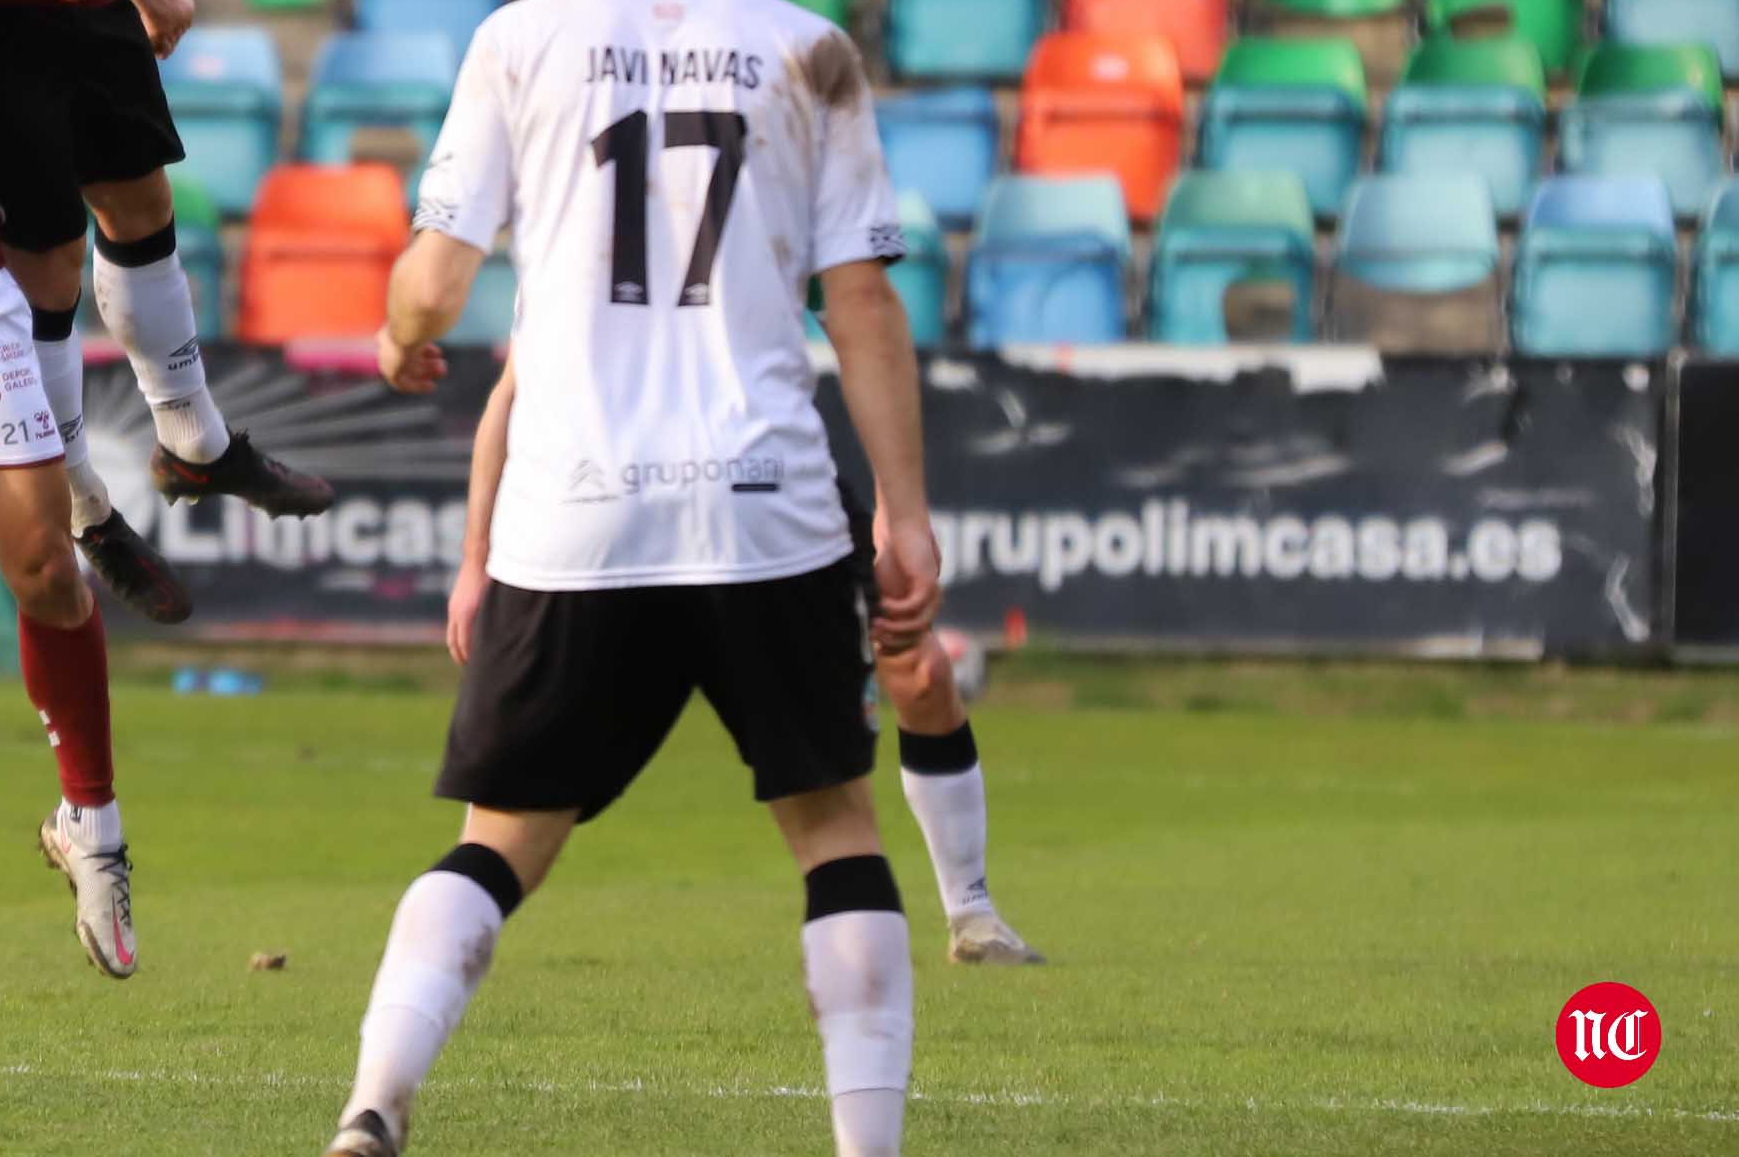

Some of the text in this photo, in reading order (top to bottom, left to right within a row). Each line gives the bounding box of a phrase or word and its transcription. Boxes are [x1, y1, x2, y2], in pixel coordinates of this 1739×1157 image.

[583, 47, 764, 90] JAVI NAVAS
[591, 109, 748, 306] 17
[1, 419, 29, 445] 21
